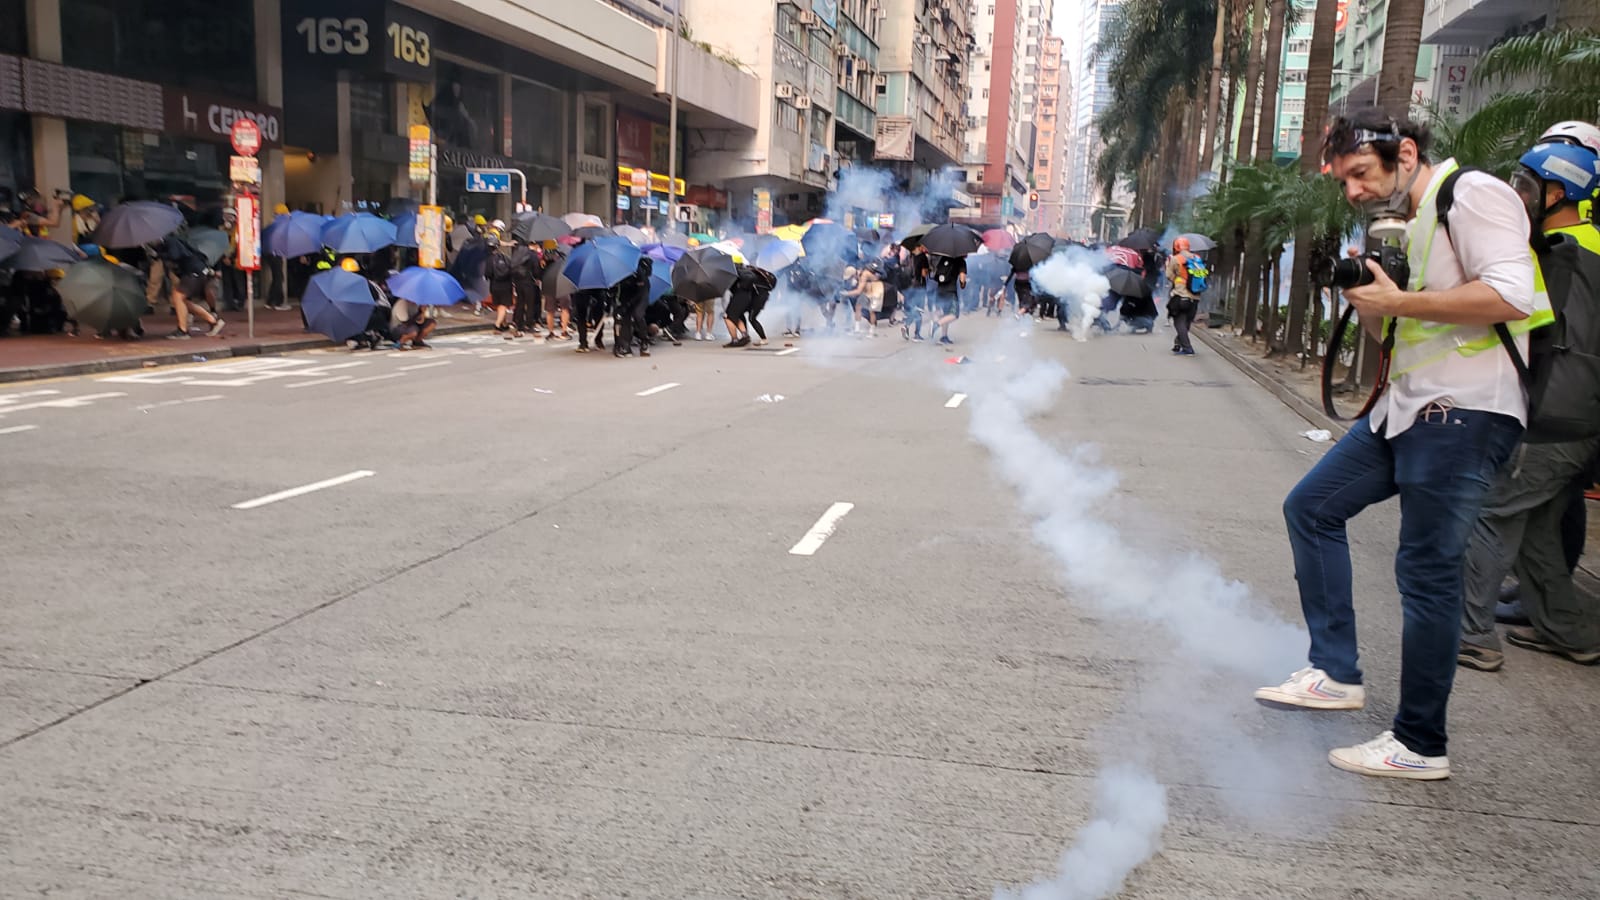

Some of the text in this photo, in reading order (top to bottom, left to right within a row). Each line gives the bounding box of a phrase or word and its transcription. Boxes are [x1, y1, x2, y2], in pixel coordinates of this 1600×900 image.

[296, 17, 369, 55] 163
[387, 22, 430, 67] 163
[207, 104, 279, 142] CERO
